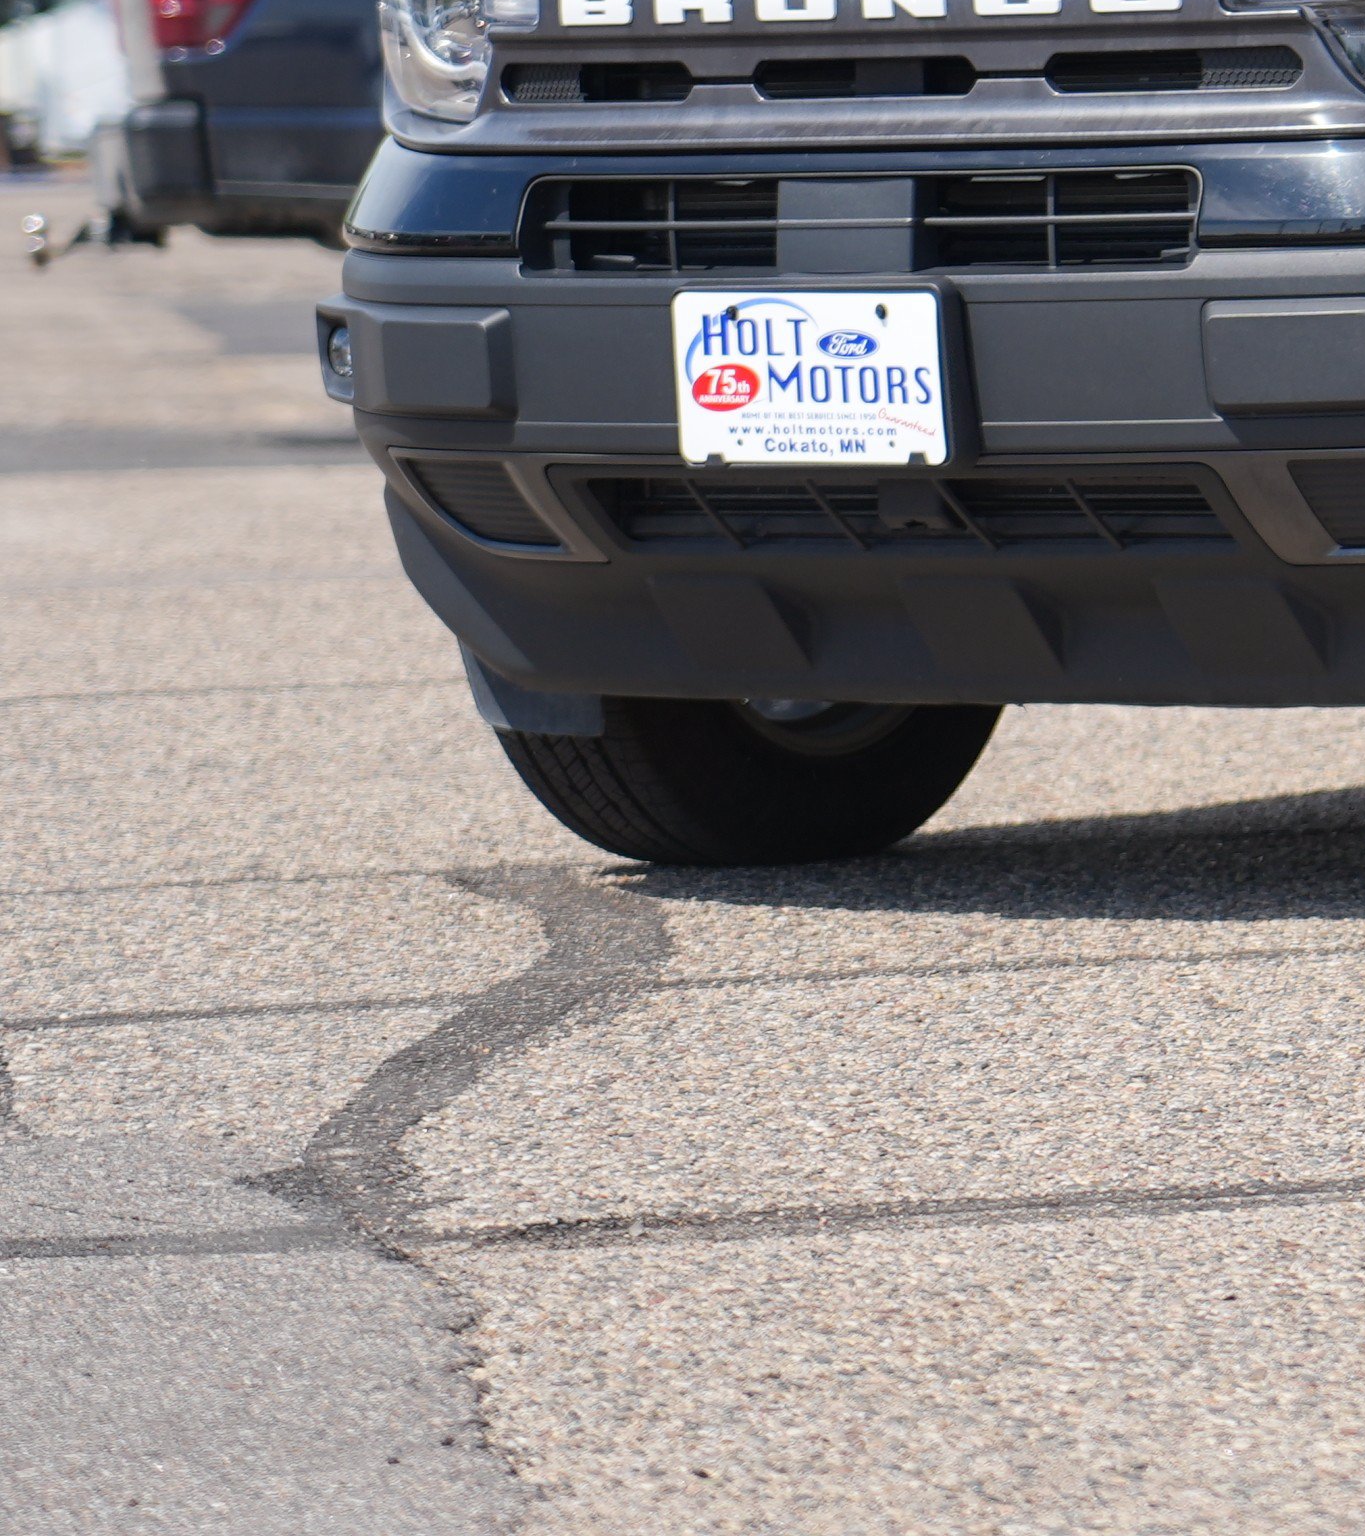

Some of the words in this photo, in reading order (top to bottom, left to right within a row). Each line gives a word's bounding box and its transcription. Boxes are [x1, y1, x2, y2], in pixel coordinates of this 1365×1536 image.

[702, 313, 807, 356] HOLT
[828, 331, 869, 357] Ford
[707, 368, 751, 394] 75th
[767, 361, 932, 404] MOTORS
[699, 394, 750, 404] ANNIVERSARY
[859, 412, 876, 420] 1950
[728, 425, 897, 436] www.holtmotors.com
[764, 438, 833, 455] Cokato,
[840, 439, 866, 452] MN
